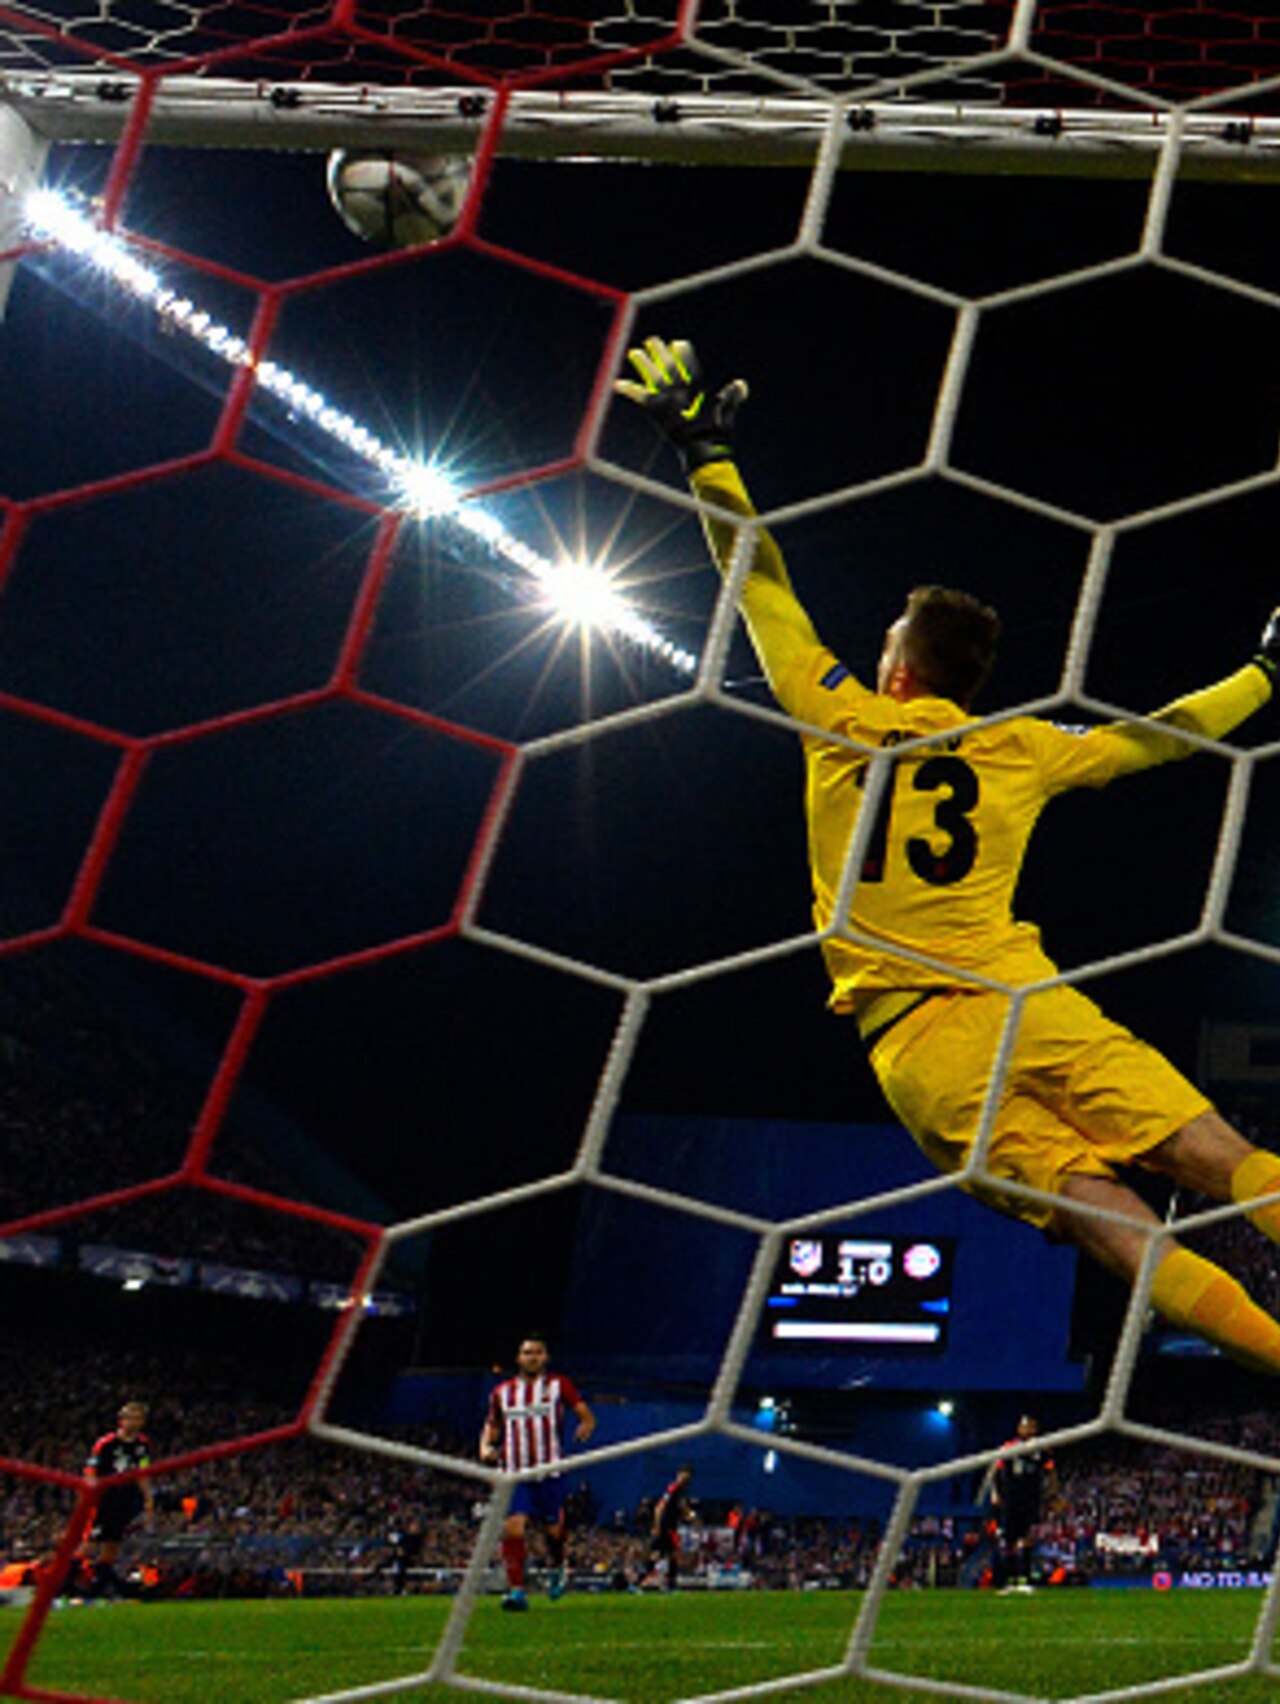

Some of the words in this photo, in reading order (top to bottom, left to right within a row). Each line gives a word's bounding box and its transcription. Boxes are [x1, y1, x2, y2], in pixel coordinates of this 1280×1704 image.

[855, 756, 980, 886] 13
[837, 1257, 892, 1286] 1:0
[1181, 1571, 1214, 1588] NO
[1217, 1571, 1242, 1588] TO
